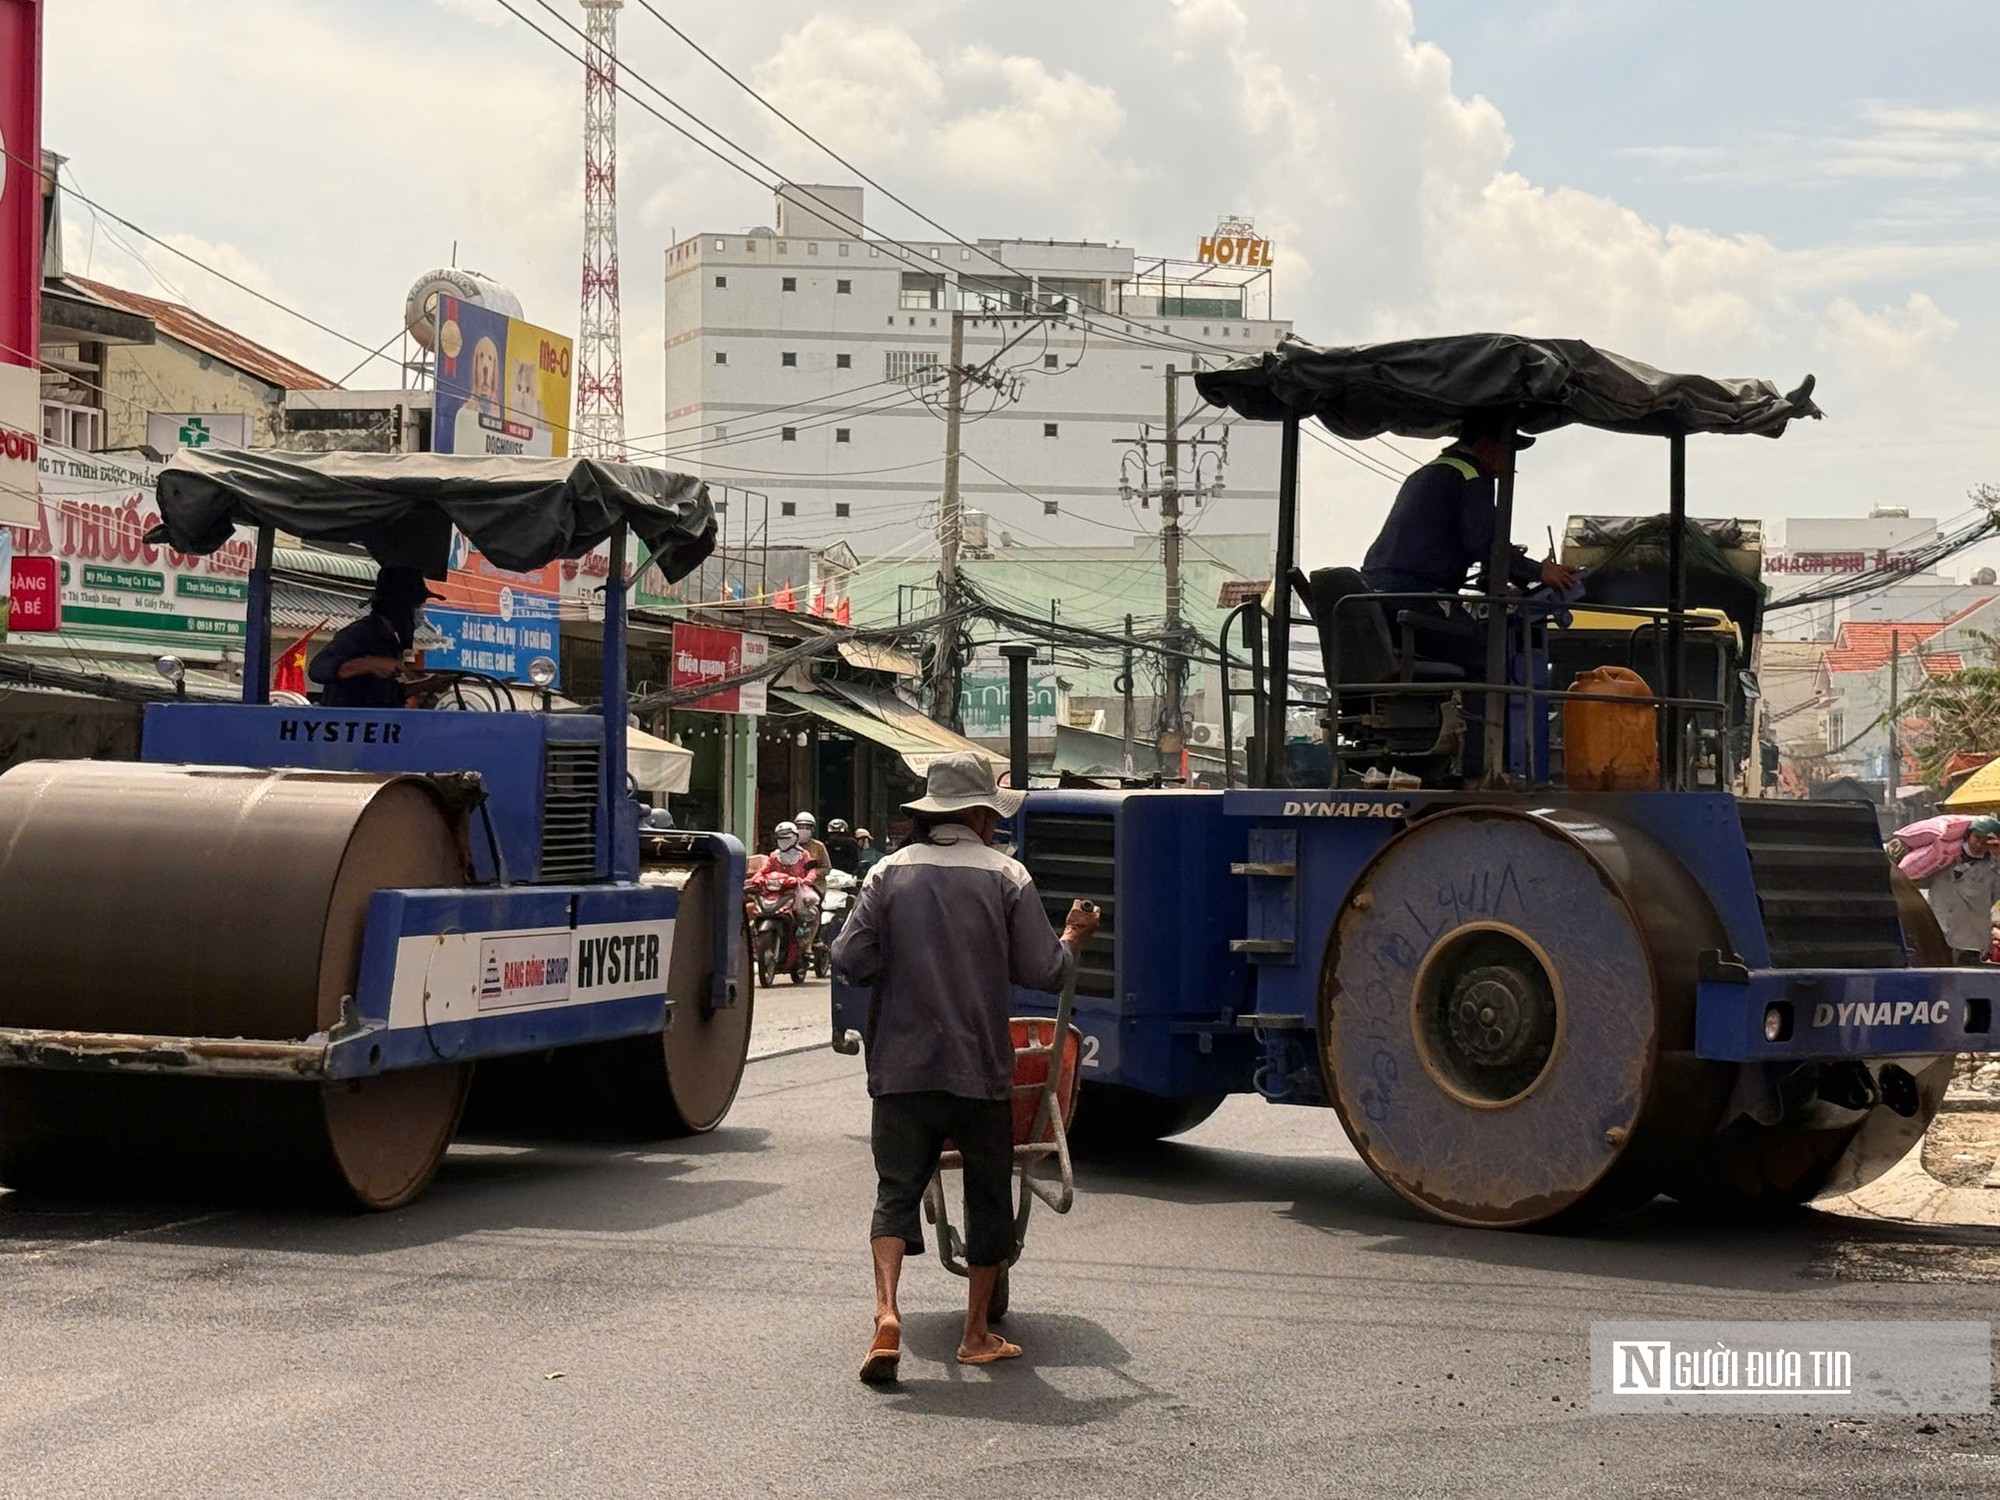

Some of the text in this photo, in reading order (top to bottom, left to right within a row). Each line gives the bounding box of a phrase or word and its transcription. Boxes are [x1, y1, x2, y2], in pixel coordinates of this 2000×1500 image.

[1198, 236, 1273, 266] HOTEL
[0, 427, 38, 463] on
[52, 459, 66, 475] TY
[69, 462, 98, 480] TNHH
[24, 597, 41, 615] BÉ
[700, 659, 726, 682] quang
[279, 720, 402, 744] HYSTER
[1283, 801, 1404, 818] DYNAPAC
[546, 957, 568, 985] GROUP
[578, 934, 660, 989] HYSTER
[1812, 1000, 1949, 1028] DYNAPAC
